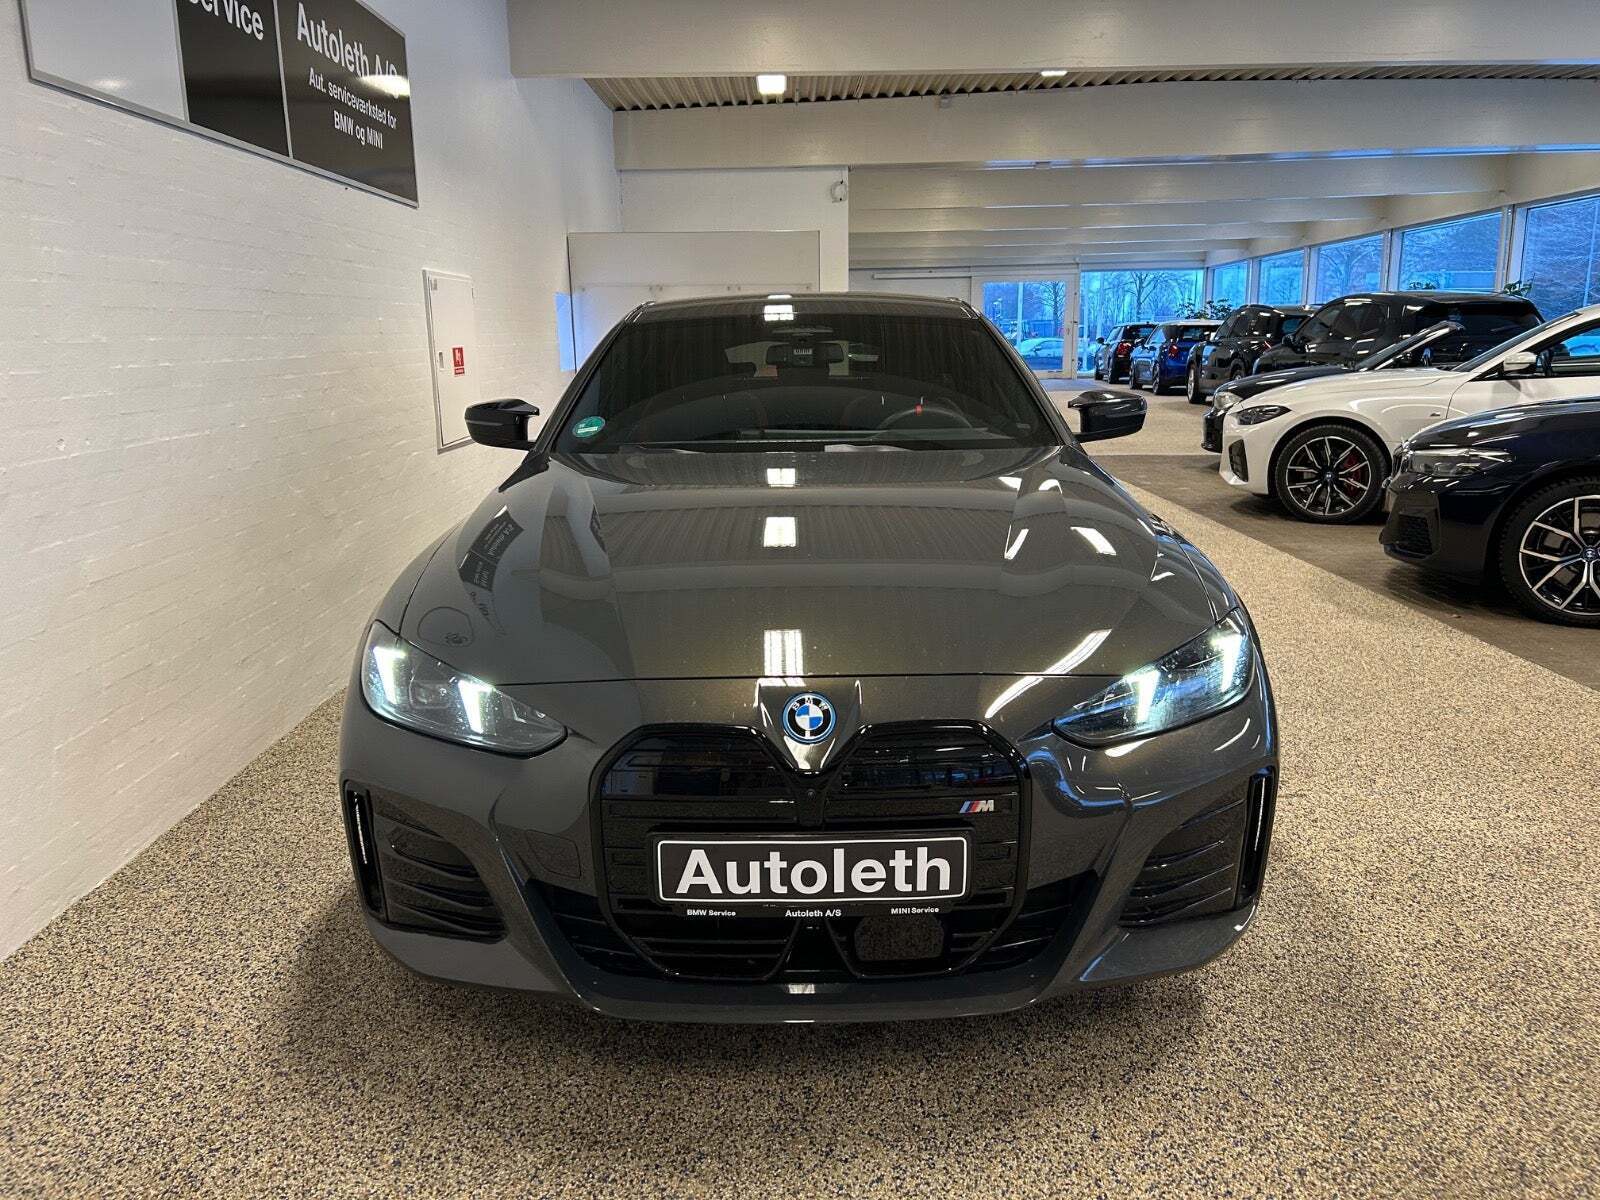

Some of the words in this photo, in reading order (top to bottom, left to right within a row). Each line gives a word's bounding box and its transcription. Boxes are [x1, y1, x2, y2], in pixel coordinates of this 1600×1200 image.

[297, 2, 369, 78] Autoleth
[309, 67, 326, 93] Aut.
[328, 81, 387, 124] serviceværksted
[387, 110, 397, 129] for
[333, 110, 354, 136] BMW
[355, 124, 366, 145] og
[367, 126, 383, 149] MINI
[675, 847, 950, 894] Autoleth
